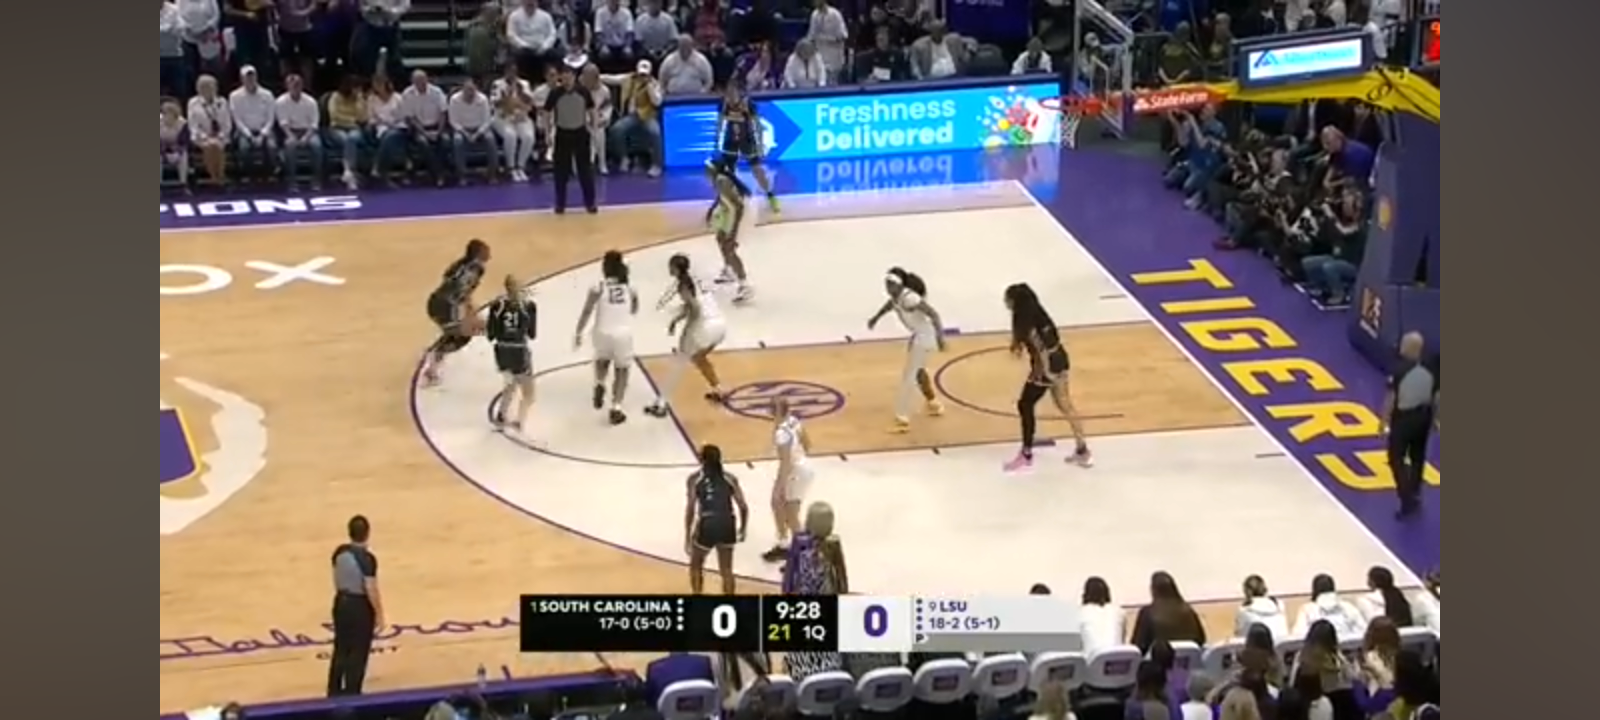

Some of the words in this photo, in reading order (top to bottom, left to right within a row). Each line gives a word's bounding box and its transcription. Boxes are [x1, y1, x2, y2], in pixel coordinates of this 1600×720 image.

[816, 99, 957, 126] Freshness
[817, 121, 954, 151] Delivered
[608, 287, 625, 304] 12
[503, 311, 519, 328] 21
[1130, 258, 1440, 490] TIGERS
